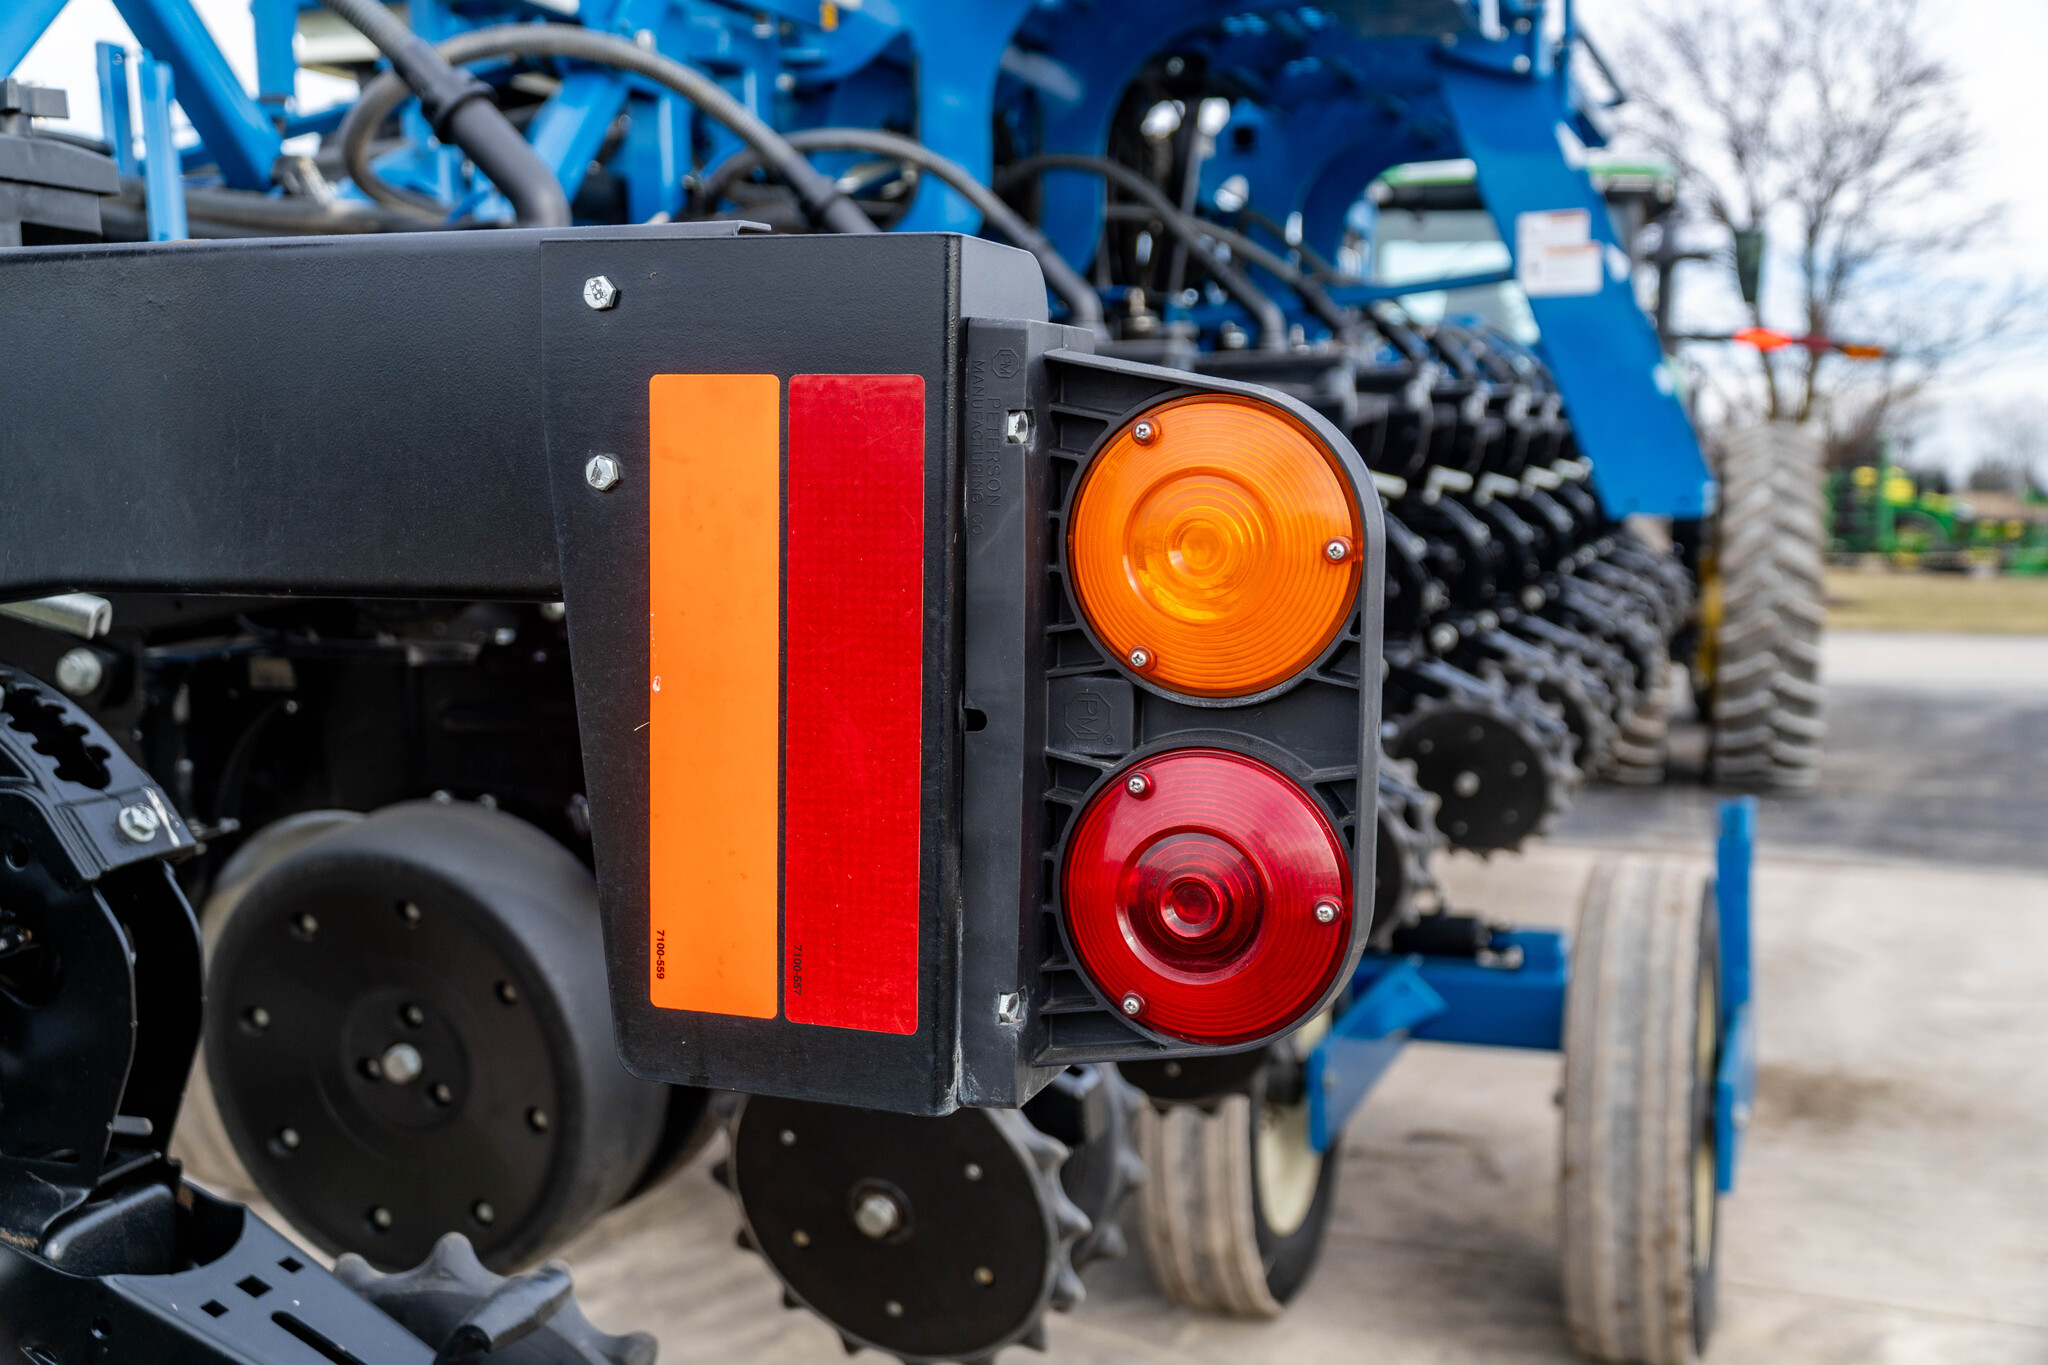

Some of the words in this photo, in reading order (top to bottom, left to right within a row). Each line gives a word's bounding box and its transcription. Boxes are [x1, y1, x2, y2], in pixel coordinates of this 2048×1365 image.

[970, 360, 985, 503] MANUFACTURING
[987, 397, 1001, 508] PETERSON
[656, 930, 665, 979] 7100-559
[793, 945, 802, 995] 7100-557
